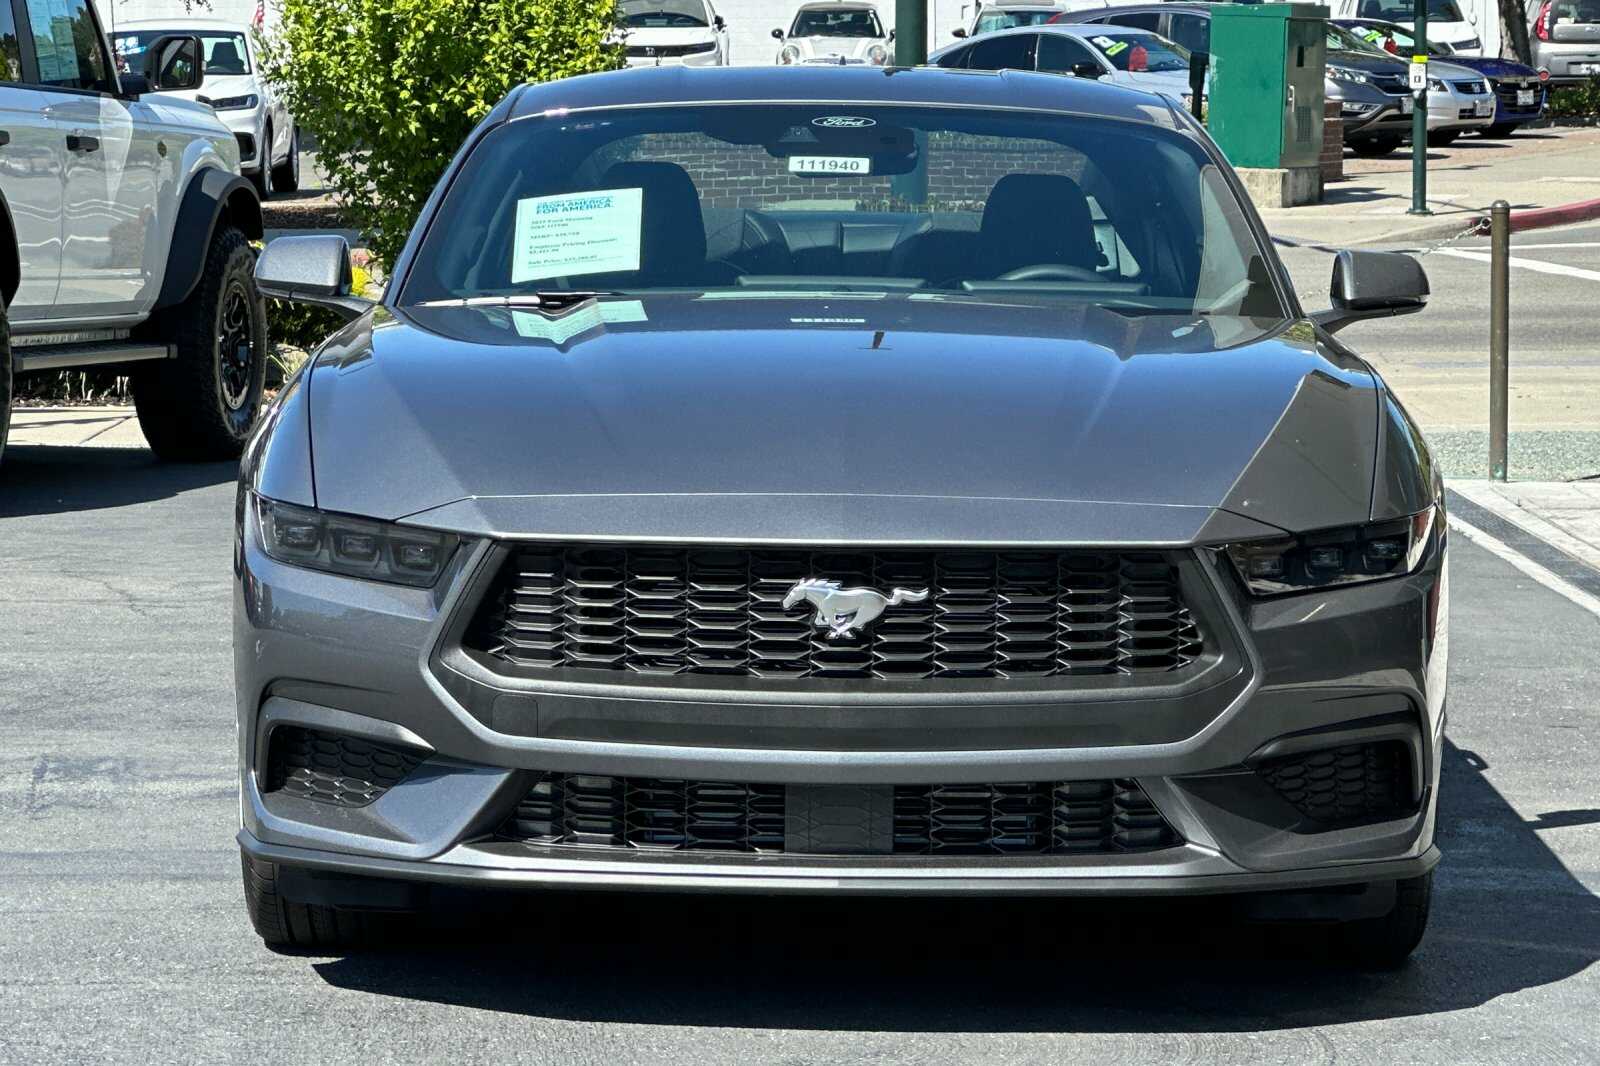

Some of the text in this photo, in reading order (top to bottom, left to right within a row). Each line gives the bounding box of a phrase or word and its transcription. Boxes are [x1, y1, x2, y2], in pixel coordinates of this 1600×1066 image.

[822, 117, 865, 127] Ford
[797, 160, 860, 171] 111940
[536, 201, 567, 210] FROM
[536, 207, 559, 215] FOR
